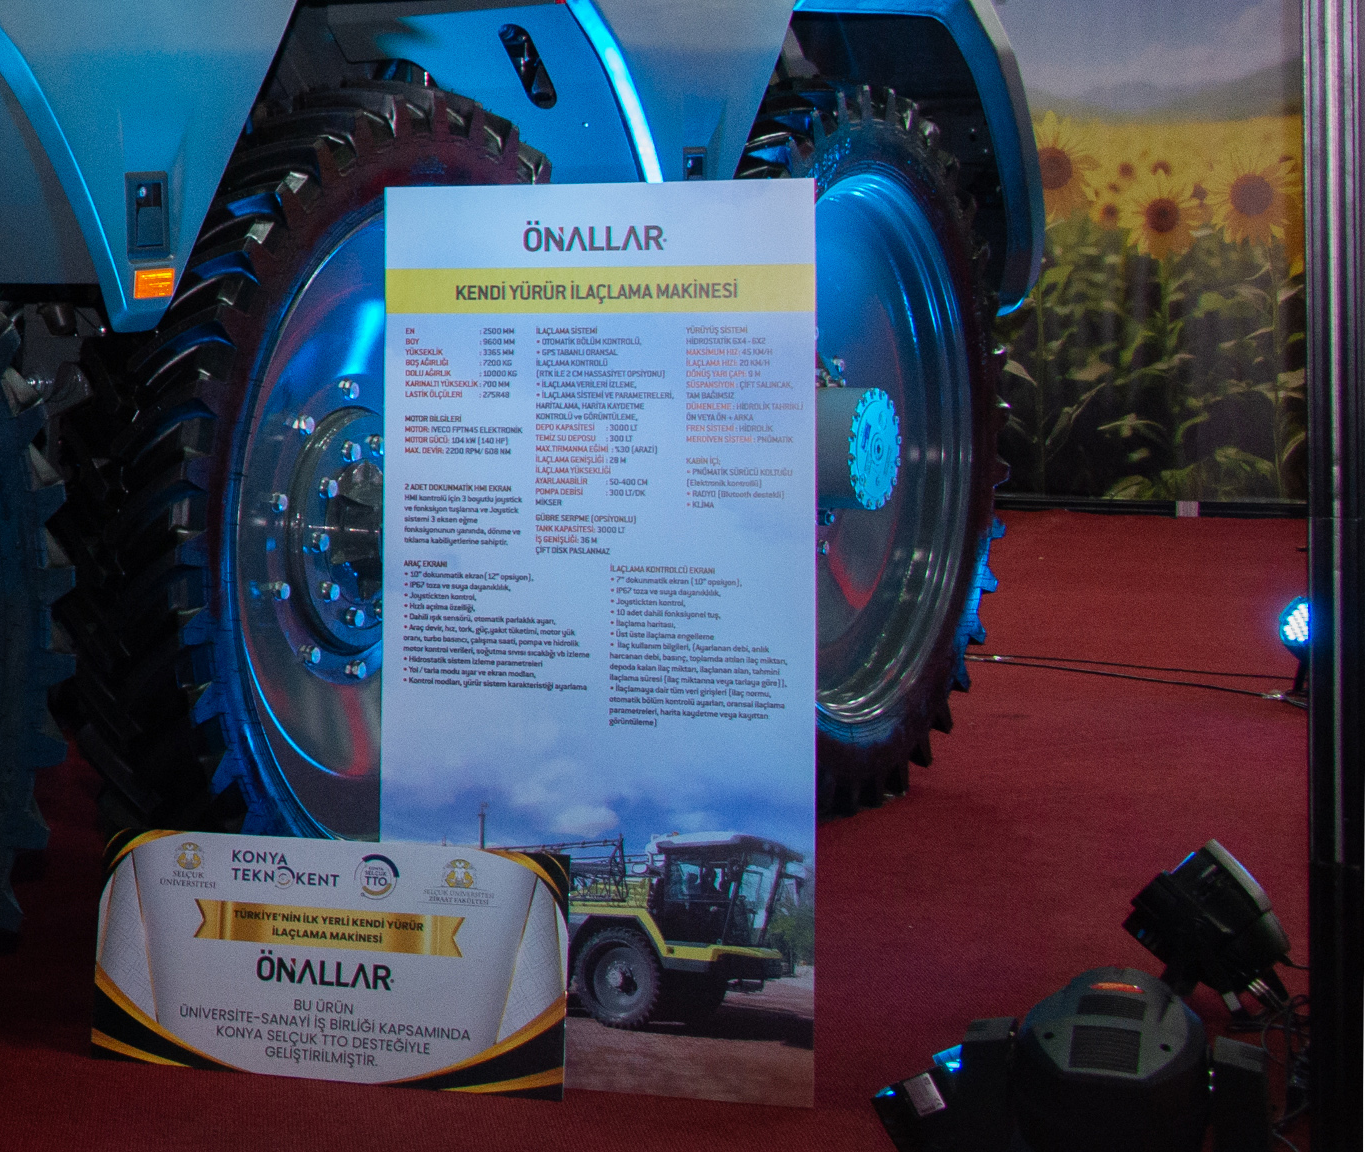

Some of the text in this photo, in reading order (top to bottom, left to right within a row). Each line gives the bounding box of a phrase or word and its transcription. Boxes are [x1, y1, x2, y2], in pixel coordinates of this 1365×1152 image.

[523, 221, 664, 252] ÖNALLAR
[456, 279, 738, 304] KENDİ YÜRÜR İLAÇLAMA MAKİNESİ
[232, 850, 288, 865] KONYA
[365, 876, 387, 886] TTO
[234, 910, 423, 931] TÜRKİYE'NİN İLK YERLİ KENDİ YÜRÜR
[272, 926, 382, 944] İLAÇLAMA MAKİNESİ
[257, 949, 391, 990] ÖNALLAR
[294, 999, 353, 1014] BU ÜRÜN
[180, 1004, 470, 1040] ÜNİVERSİTE-SANAYİ İŞ BİRLİĞİ KAPSAMINDA
[217, 1026, 430, 1055] KONYA SELÇUK TTO DESTEĞİYLE
[265, 1046, 378, 1067] GELİŞTİRİLMİŞTİR.
